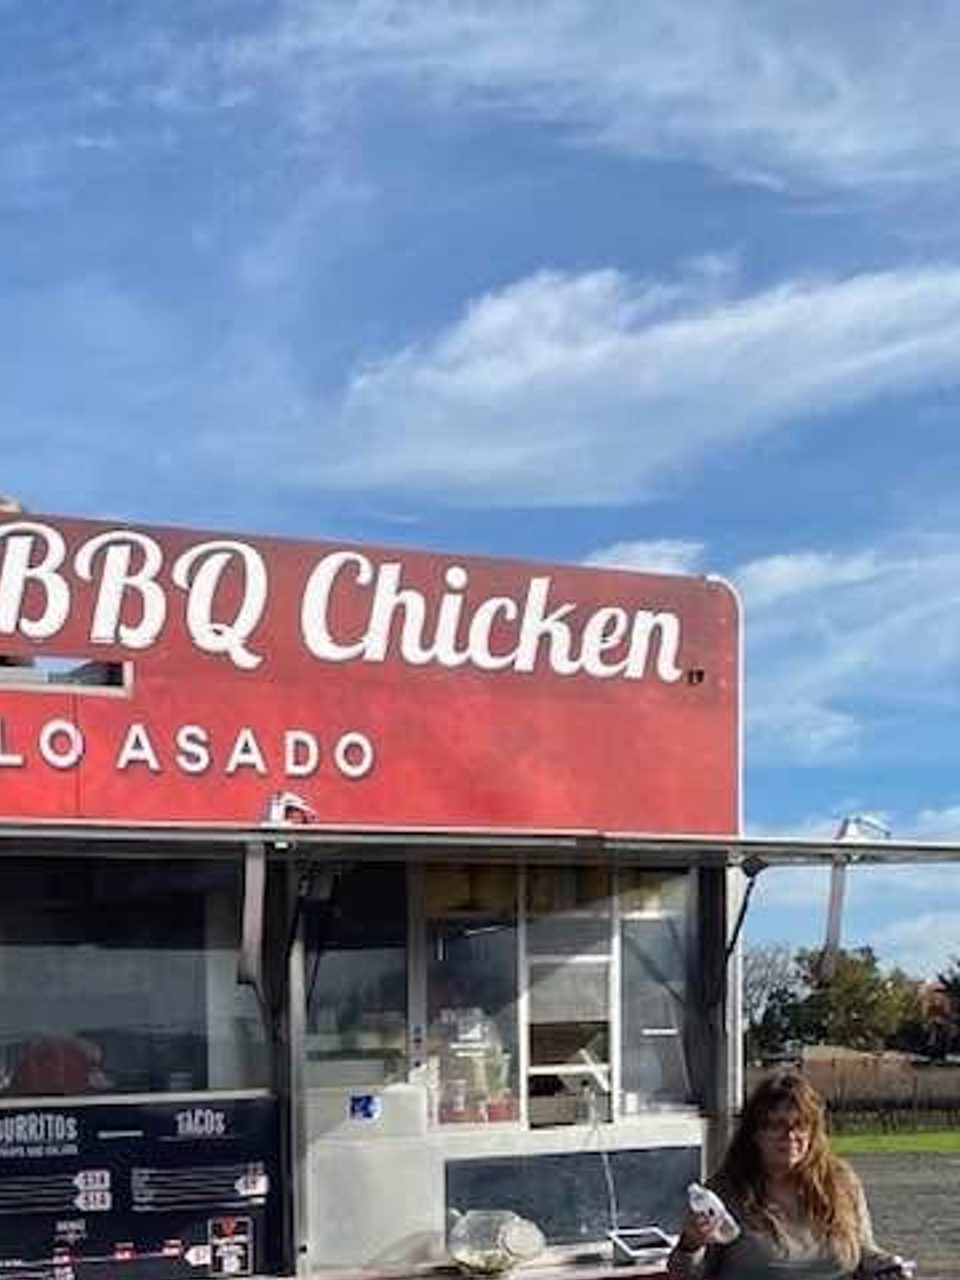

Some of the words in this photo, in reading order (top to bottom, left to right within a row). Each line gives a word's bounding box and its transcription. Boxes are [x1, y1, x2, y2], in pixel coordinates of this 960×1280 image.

[300, 551, 683, 685] Chicken
[116, 723, 375, 778] ASADO
[174, 1108, 226, 1135] TACOS
